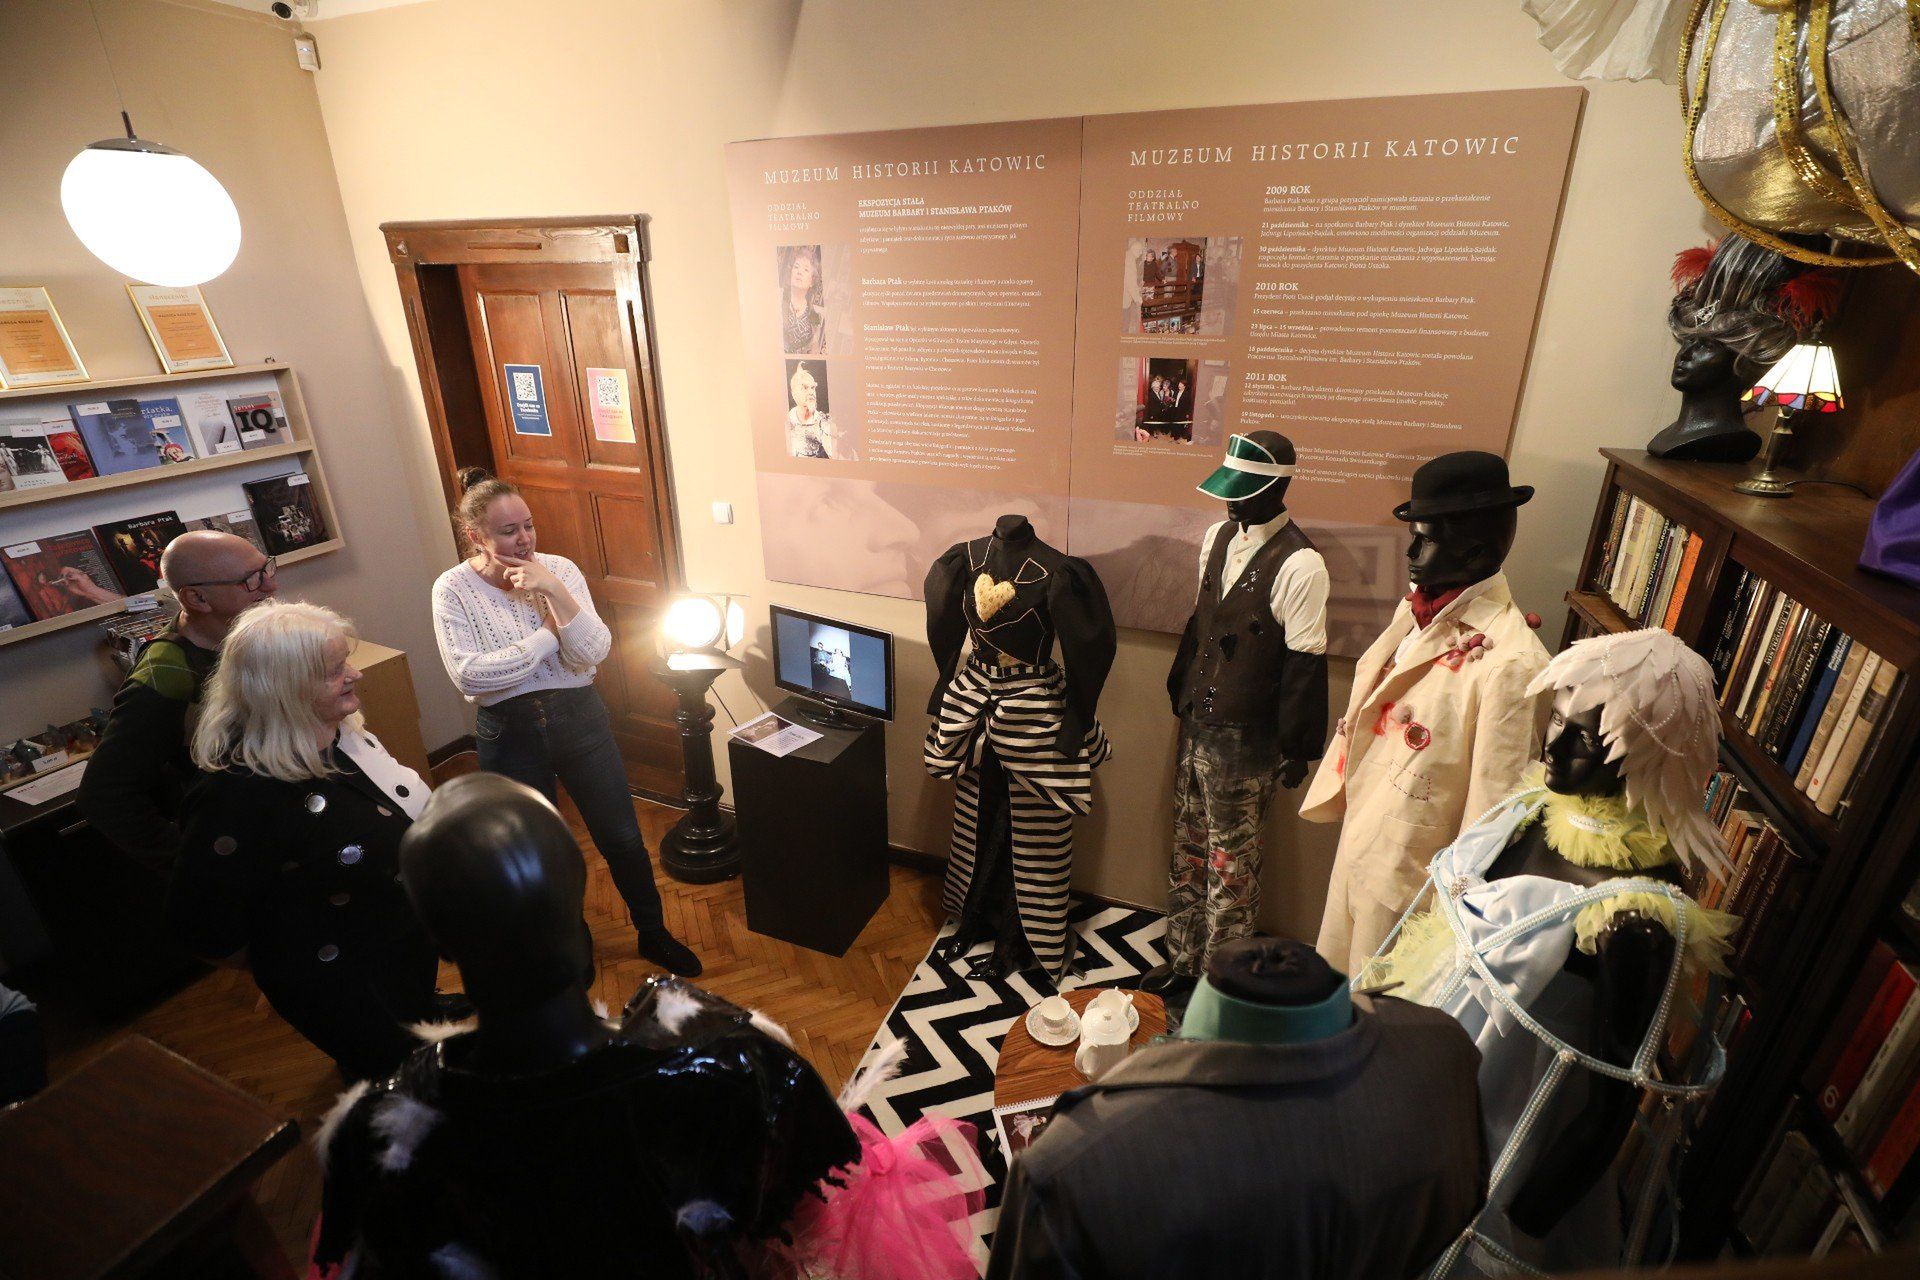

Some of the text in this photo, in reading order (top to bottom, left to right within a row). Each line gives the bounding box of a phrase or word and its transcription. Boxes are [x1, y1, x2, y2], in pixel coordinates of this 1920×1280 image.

[1130, 136, 1519, 167] MUZEUM HISTORII KATOWIC
[764, 154, 1046, 184] MUZEUM HISTORII KATOWIC
[1128, 189, 1183, 200] ODDZIAŁ
[1266, 185, 1311, 194] 2009 ROK
[858, 197, 925, 208] EKSPOZYCJA STAŁA
[1128, 200, 1199, 211] TEATRALNO
[859, 209, 891, 218] MUZEUM
[892, 208, 925, 217] BARBARY
[931, 206, 977, 216] STANISŁAWA
[979, 204, 1013, 214] PTAKÓW
[1297, 205, 1318, 213] Barbary
[768, 212, 820, 221] TEATRALNO
[1127, 212, 1184, 222] FILMOWY
[861, 277, 902, 285] Barbara Ptak
[1255, 282, 1298, 290] 2010 ROK
[1245, 372, 1264, 380] 2011
[235, 409, 276, 433] IQ
[127, 515, 172, 529] Barbara Ptak
